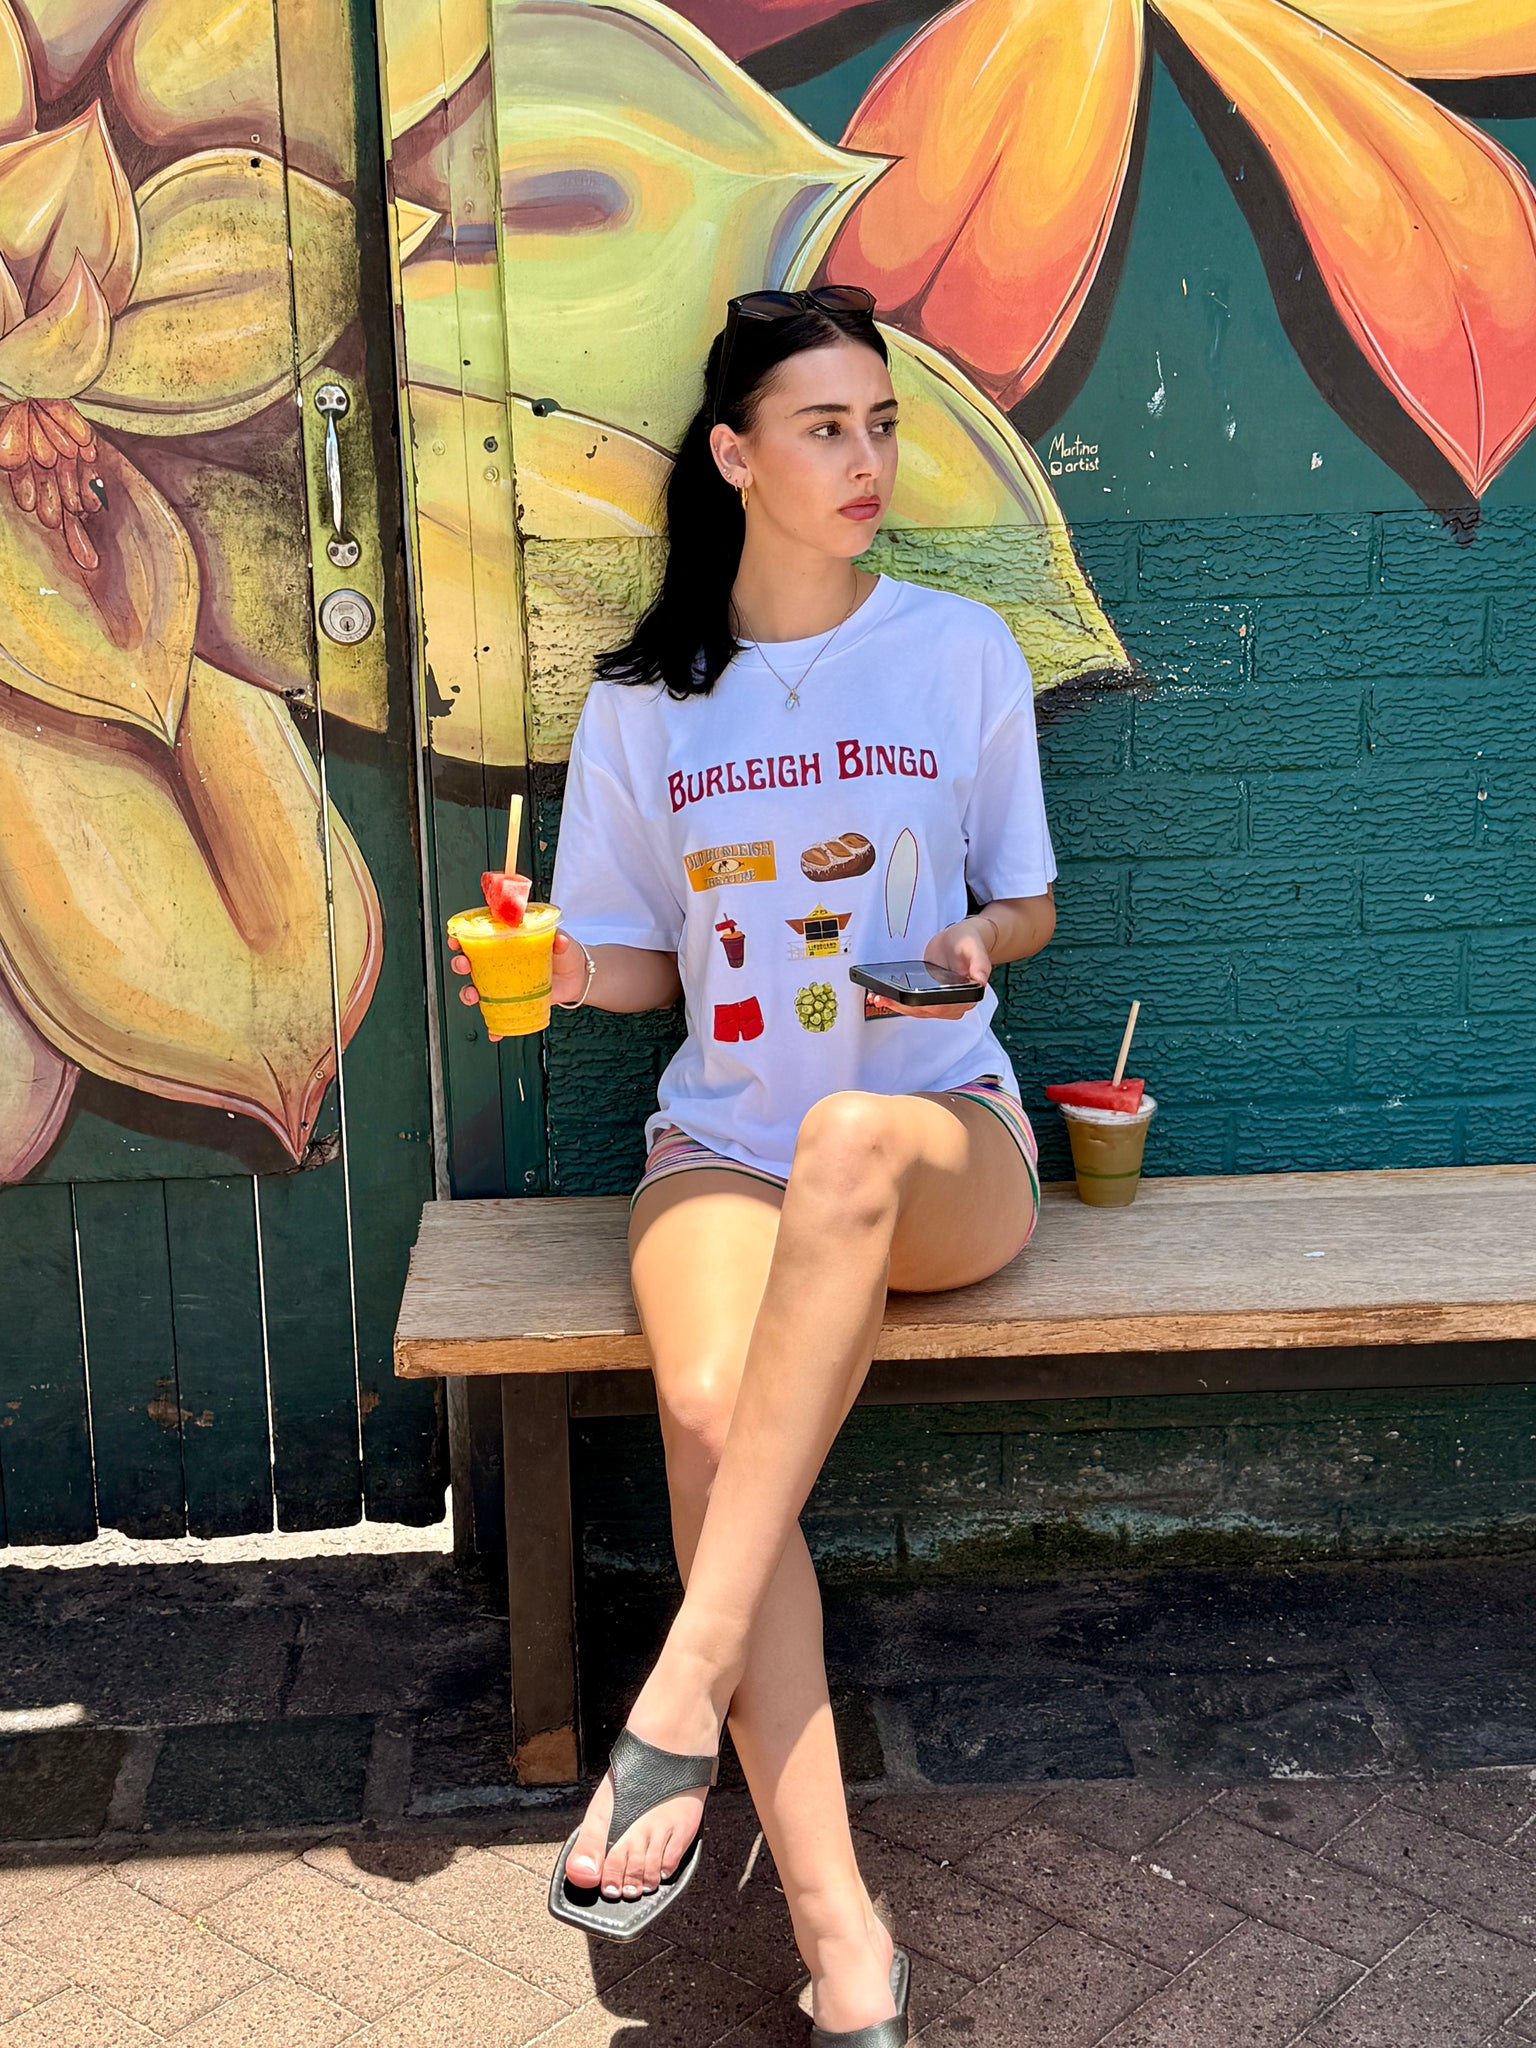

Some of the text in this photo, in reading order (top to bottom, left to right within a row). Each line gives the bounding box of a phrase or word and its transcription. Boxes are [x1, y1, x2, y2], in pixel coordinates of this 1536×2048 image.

[1048, 432, 1099, 460] Martina
[1064, 457, 1100, 473] artist
[667, 739, 938, 813] BURLEIGH BINGO
